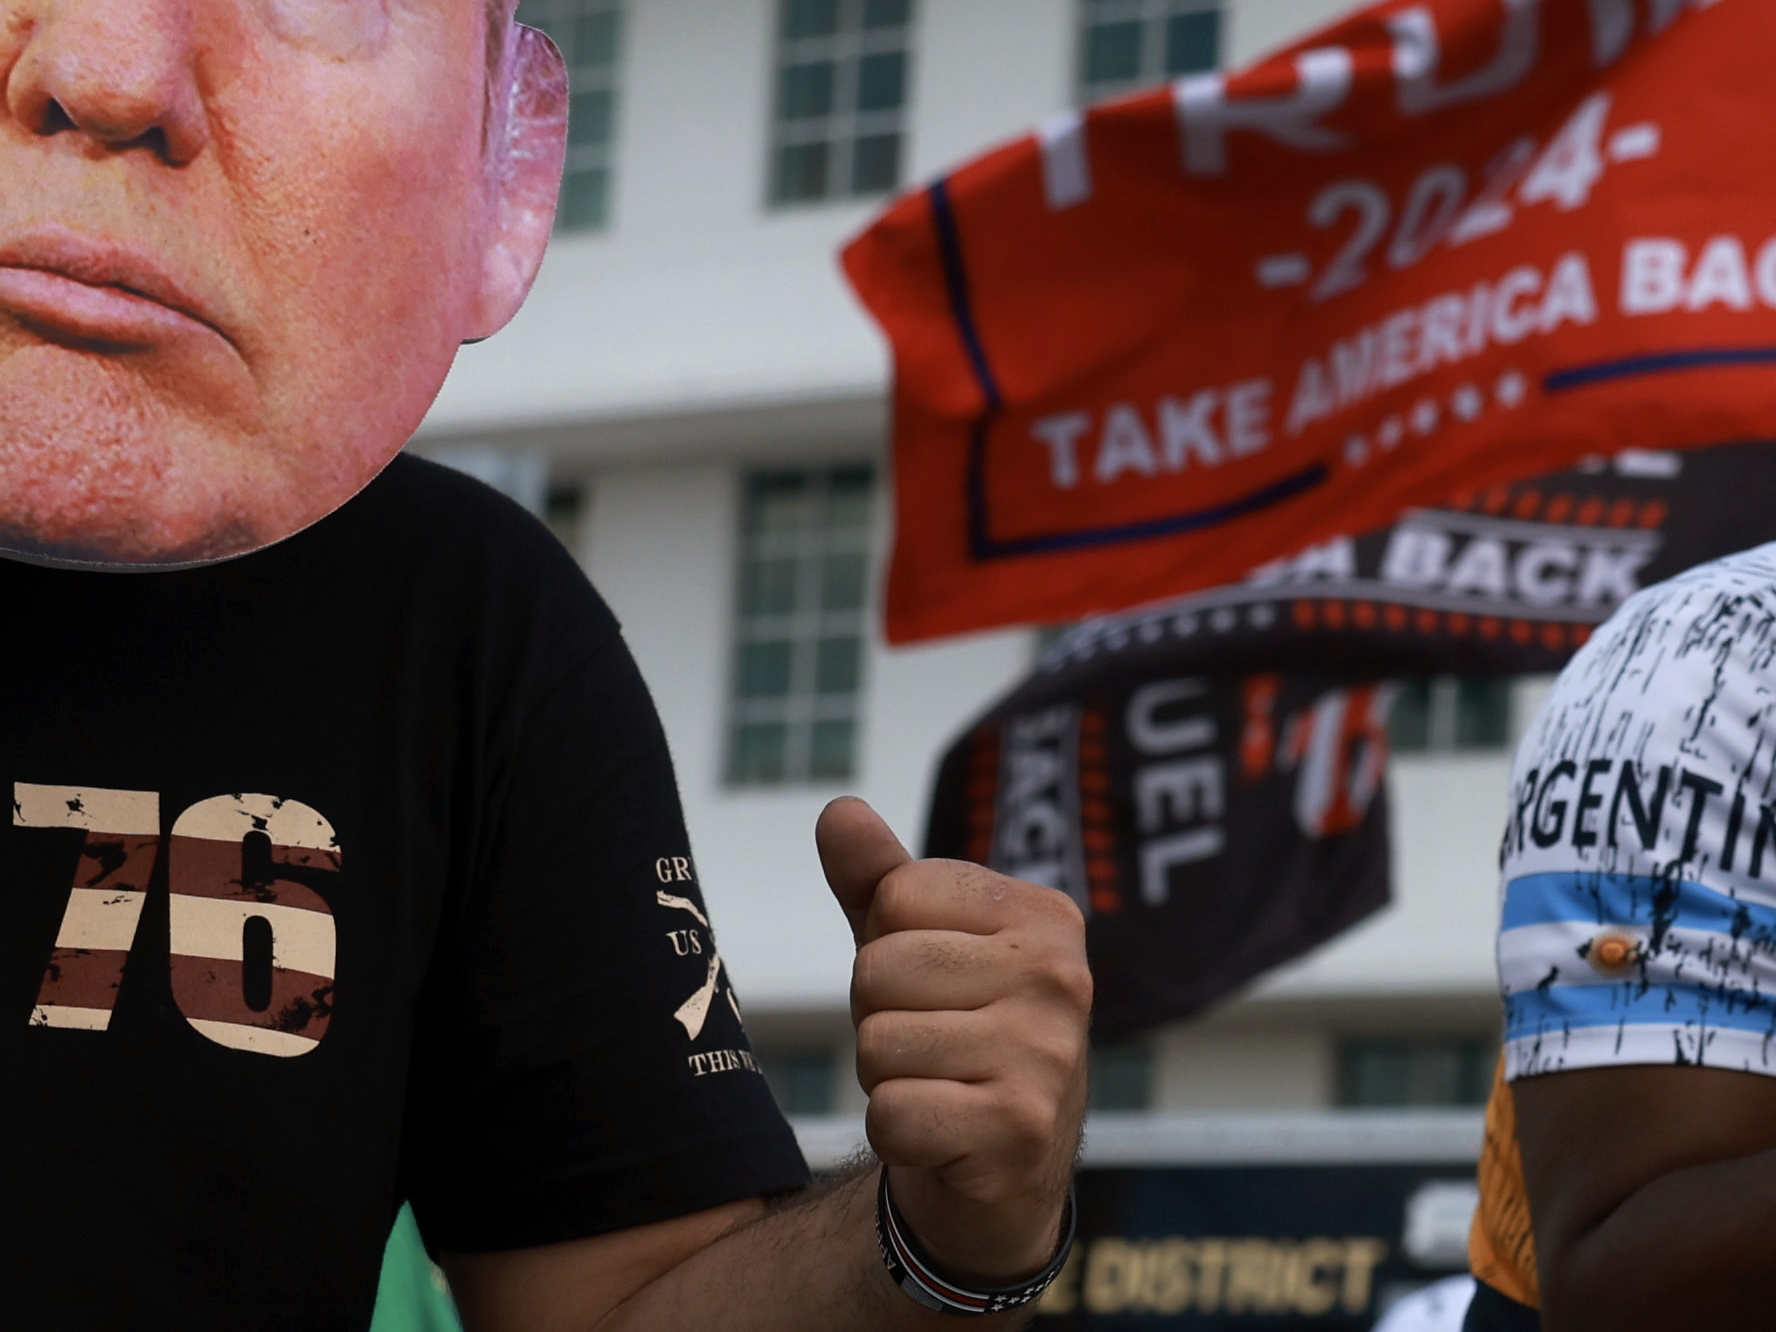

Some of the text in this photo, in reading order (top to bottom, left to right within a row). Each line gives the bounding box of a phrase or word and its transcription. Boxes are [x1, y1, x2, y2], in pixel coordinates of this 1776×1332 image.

[1032, 379, 1272, 490] TAKE
[1284, 253, 1598, 434] AMERICA
[1381, 524, 1658, 608] BACK
[655, 856, 695, 884] GR
[13, 782, 341, 1058] 76
[666, 930, 702, 956] US
[688, 1049, 740, 1077] THIS
[1086, 1236, 1386, 1315] DISTRICT
